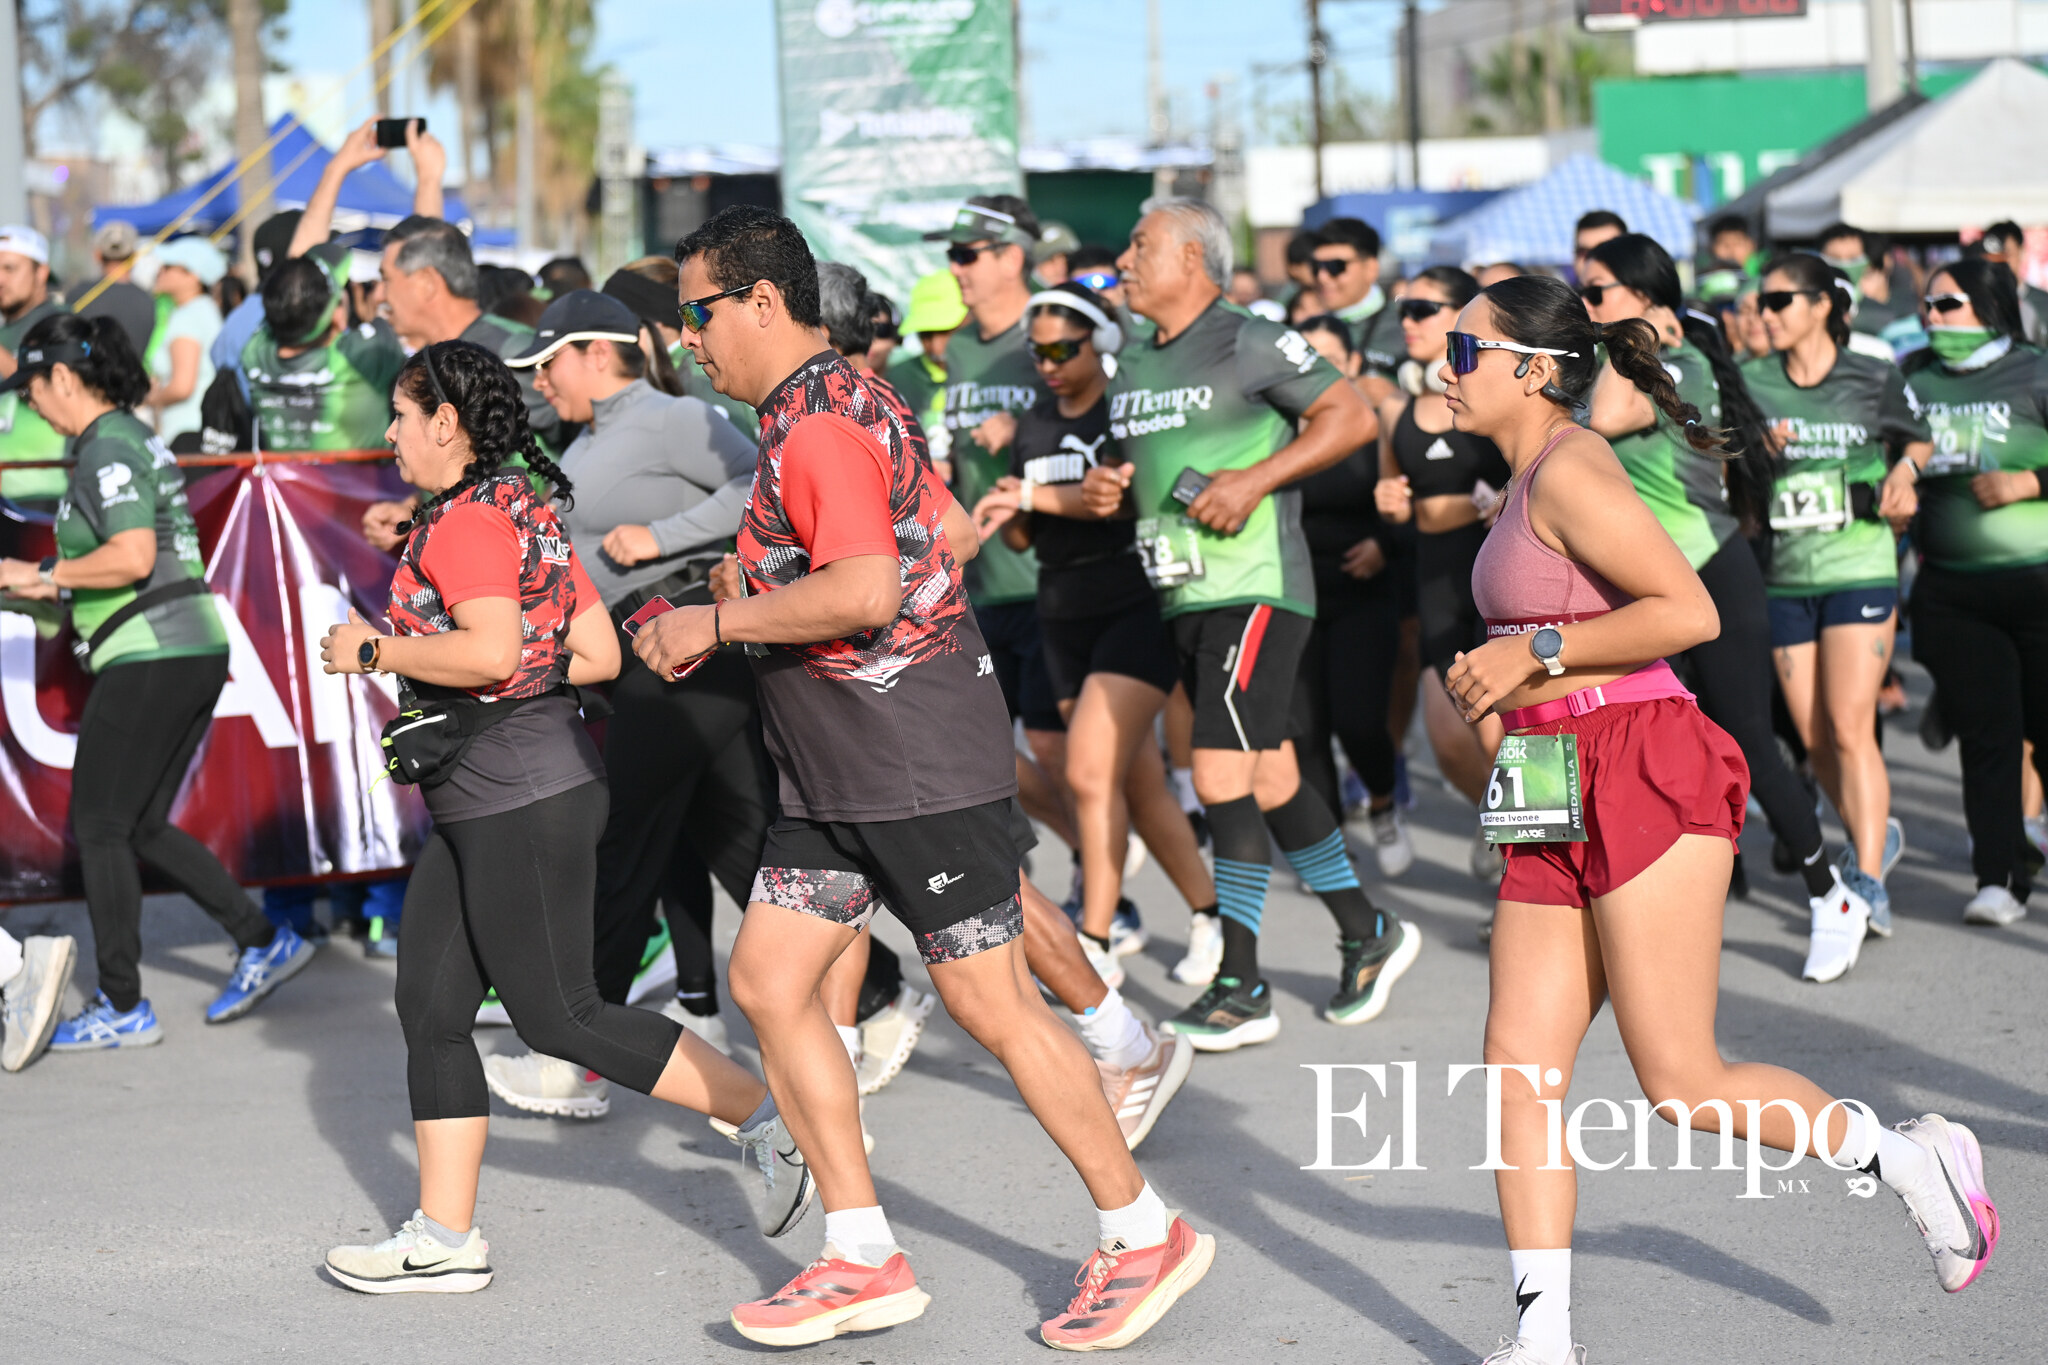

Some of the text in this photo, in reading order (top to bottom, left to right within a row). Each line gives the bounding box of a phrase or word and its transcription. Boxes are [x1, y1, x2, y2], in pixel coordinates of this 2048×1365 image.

[1130, 386, 1214, 416] Tiempo
[1128, 412, 1187, 437] todos
[1024, 452, 1085, 484] PUMA
[1780, 486, 1836, 517] 121
[1487, 766, 1526, 810] 61
[1567, 759, 1581, 829] MEDALLA
[1508, 813, 1540, 822] Ivonee
